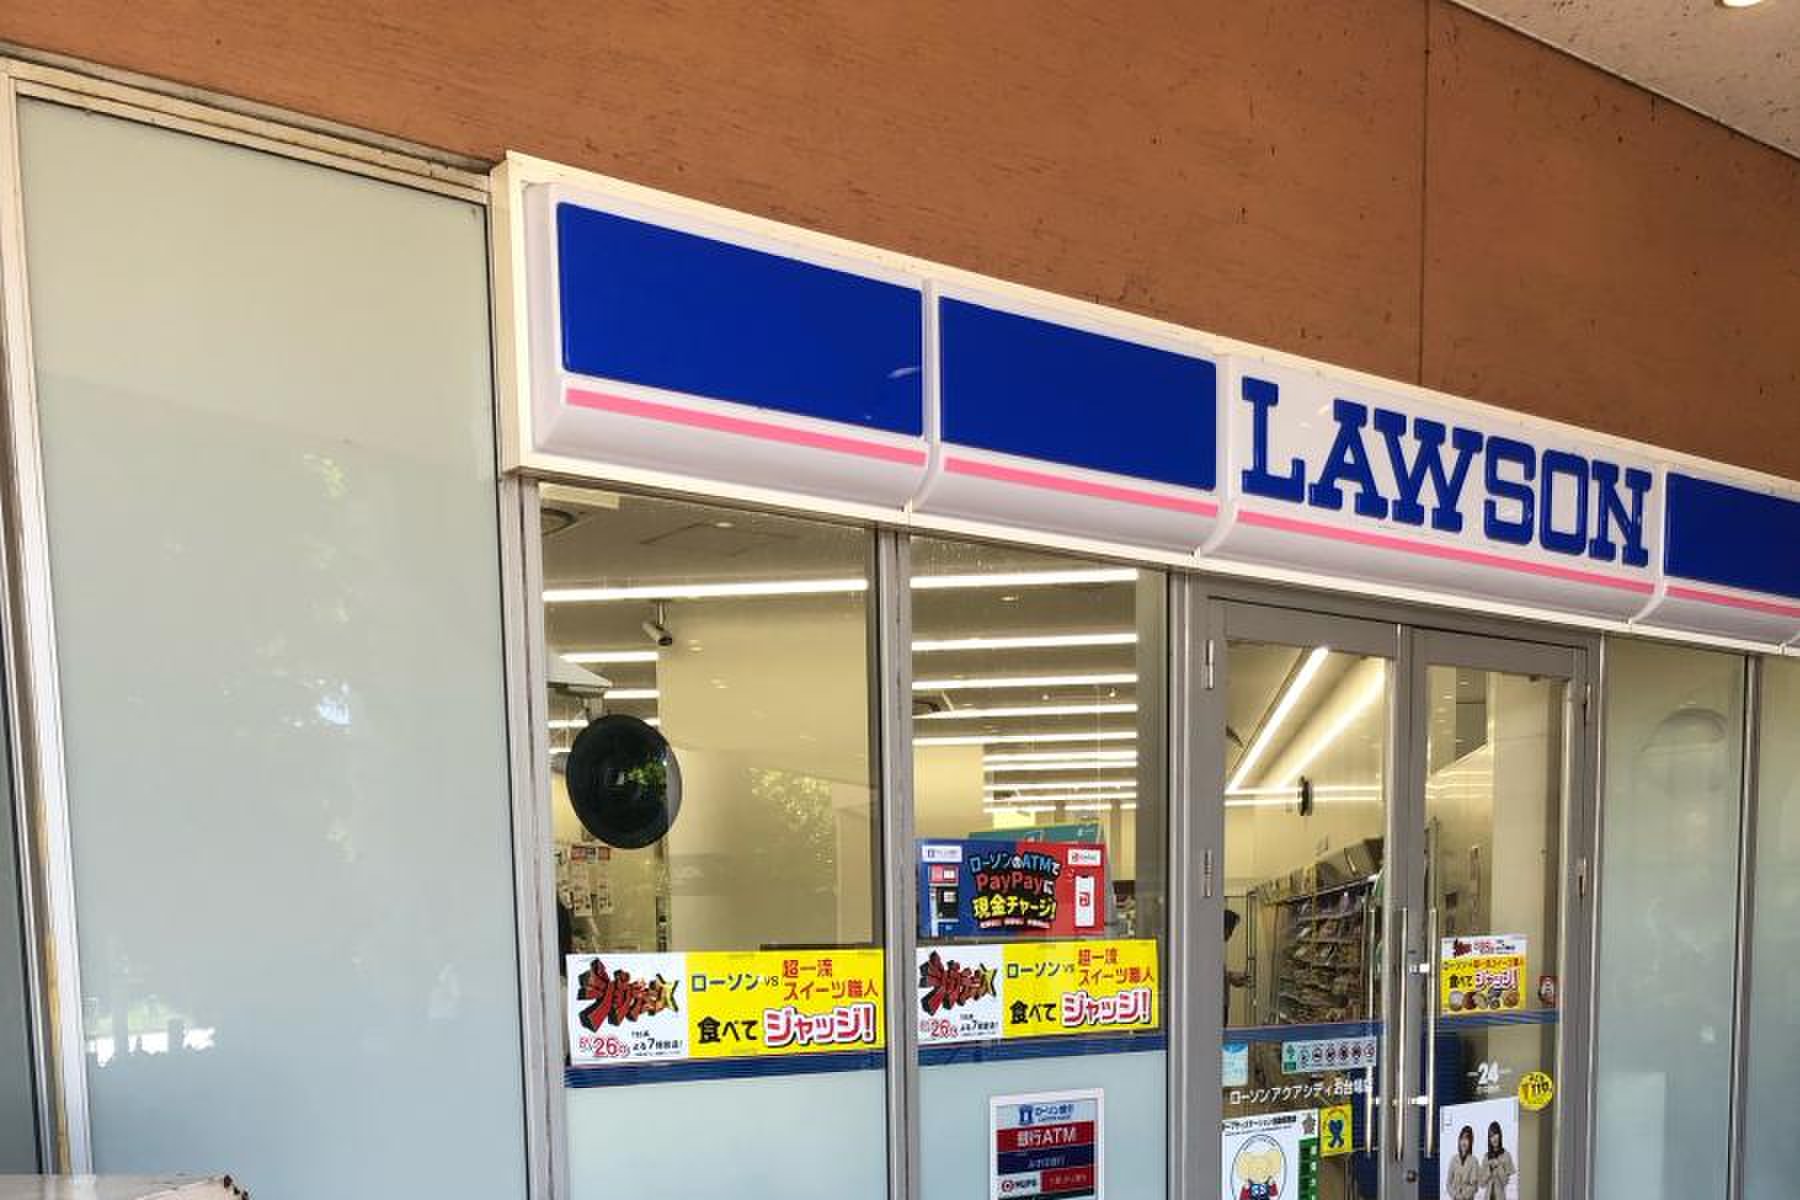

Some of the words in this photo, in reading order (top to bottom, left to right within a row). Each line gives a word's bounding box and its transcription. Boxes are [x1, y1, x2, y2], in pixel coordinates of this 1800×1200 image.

[1242, 376, 1652, 567] LAWSON
[1007, 962, 1060, 978] ローソン
[692, 973, 760, 992] ローソン
[784, 979, 879, 1001] スイーツ職人
